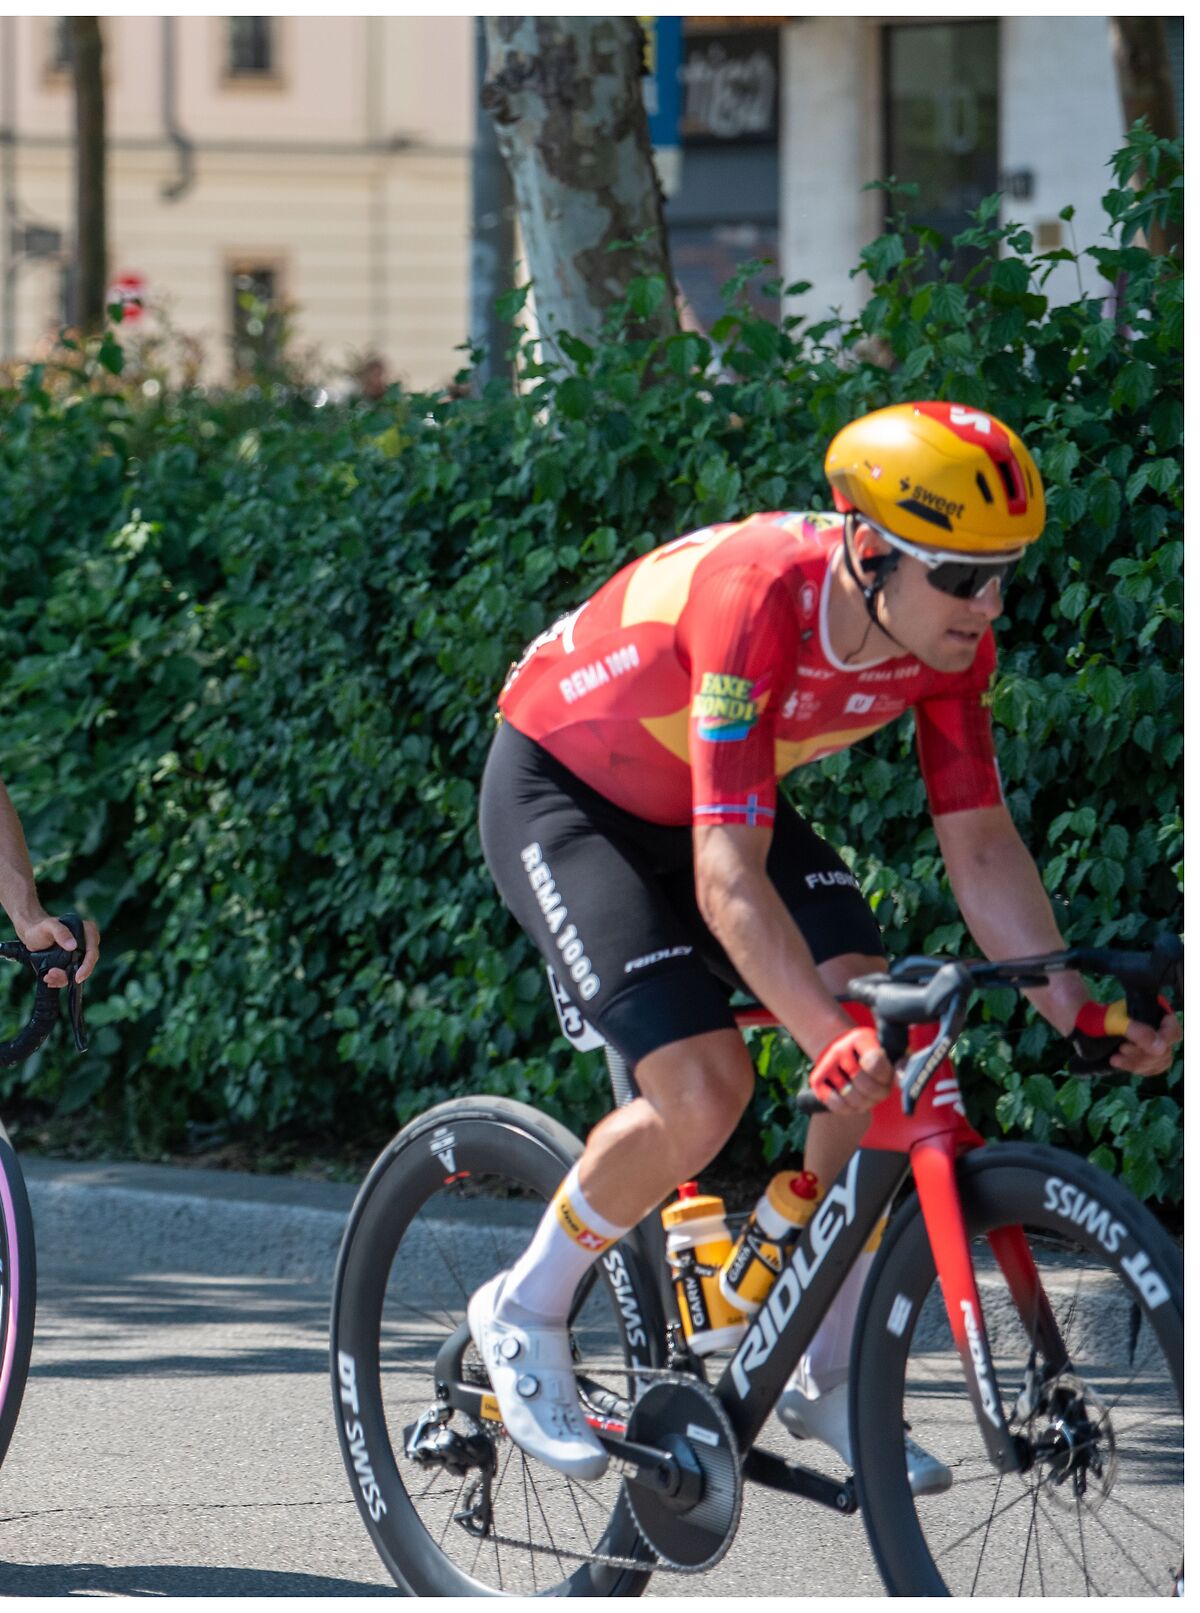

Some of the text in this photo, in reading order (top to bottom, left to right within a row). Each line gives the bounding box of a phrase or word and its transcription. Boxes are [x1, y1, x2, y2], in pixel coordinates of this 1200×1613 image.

[912, 484, 965, 519] sweet
[559, 660, 609, 704] REMA
[520, 842, 568, 934] REMA
[556, 924, 601, 1000] 1000
[624, 944, 693, 974] RIDLEY
[603, 1250, 647, 1348] SWISS
[731, 1150, 861, 1399] RIDLEY
[1043, 1177, 1171, 1310] DT SWISS
[337, 1350, 387, 1523] DT SWISS
